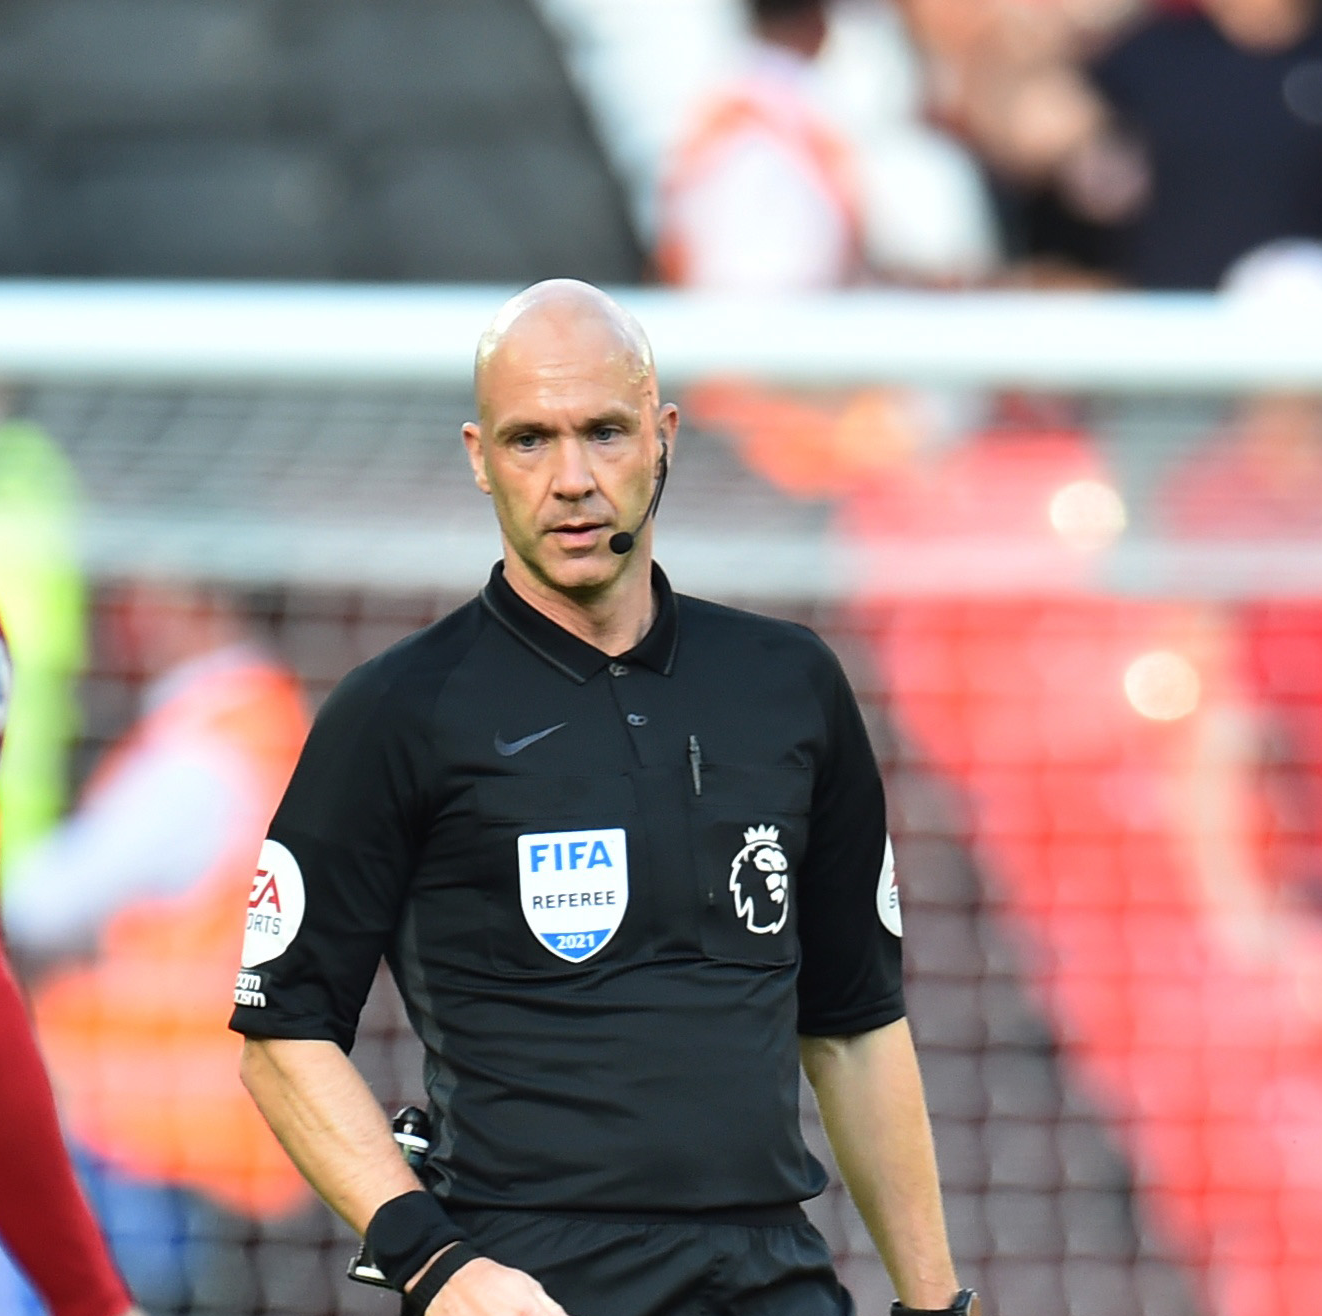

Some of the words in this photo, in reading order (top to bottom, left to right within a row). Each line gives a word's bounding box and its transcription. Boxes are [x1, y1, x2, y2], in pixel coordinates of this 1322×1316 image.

[530, 840, 613, 872] FIFA
[532, 890, 616, 910] REFEREE
[556, 933, 595, 950] 2021
